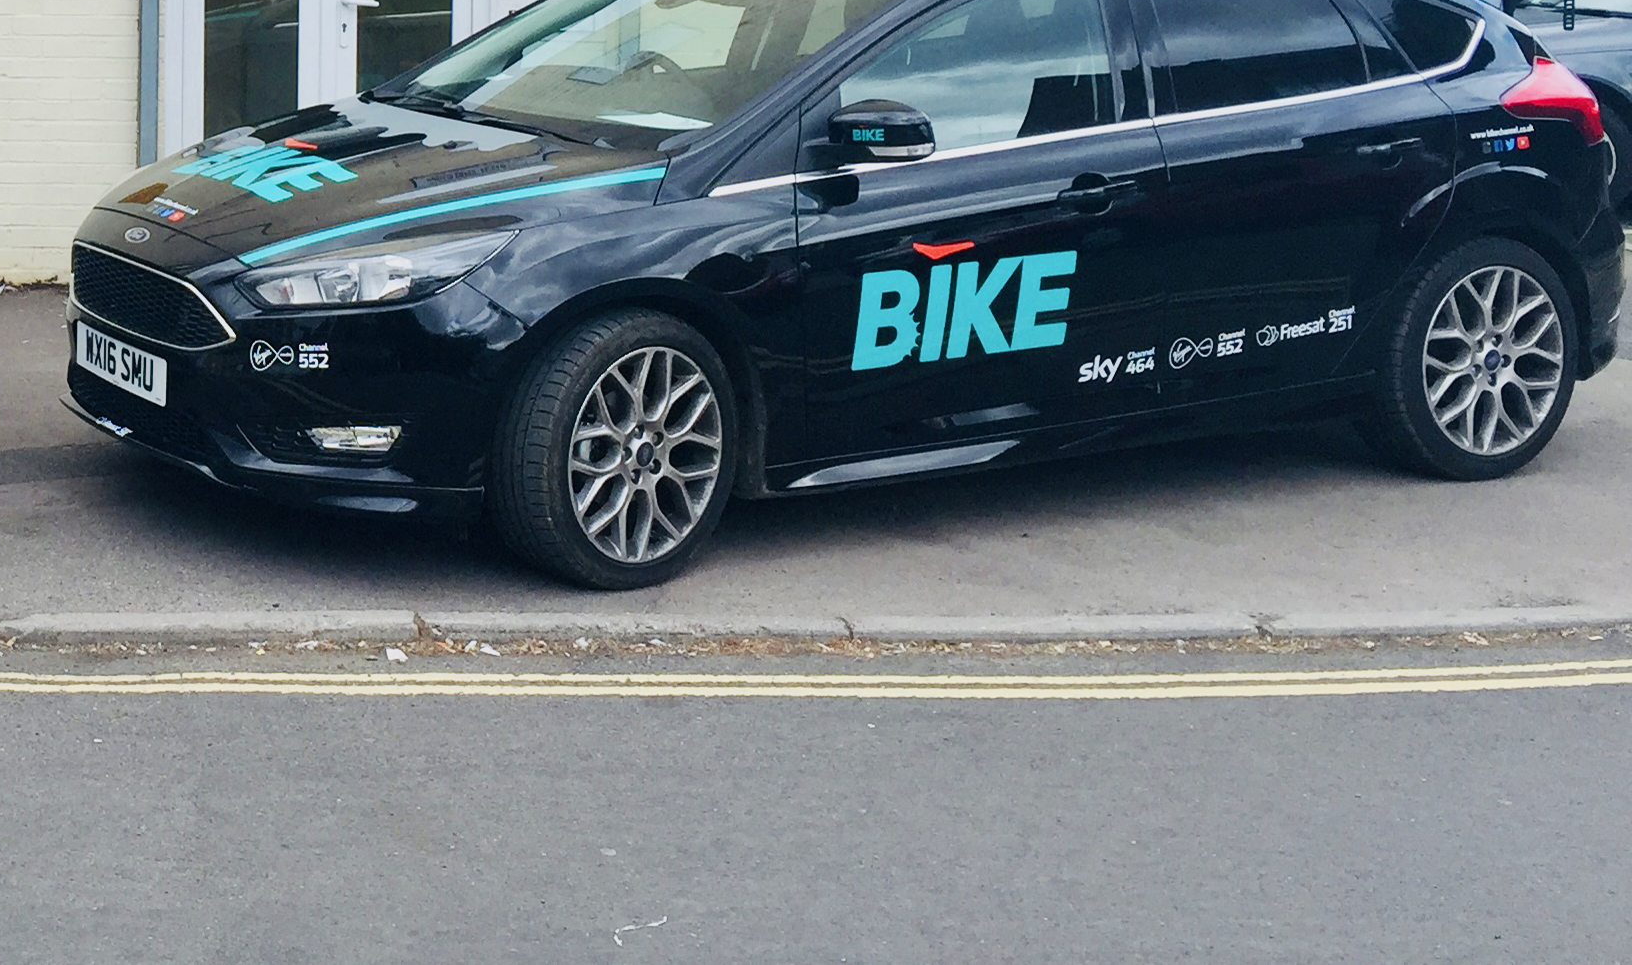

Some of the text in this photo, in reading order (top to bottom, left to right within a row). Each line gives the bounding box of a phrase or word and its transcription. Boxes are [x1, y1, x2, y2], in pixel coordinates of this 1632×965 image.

[852, 128, 885, 142] BIKE
[170, 145, 358, 203] BIKE
[851, 250, 1078, 371] BIKE
[1279, 317, 1325, 341] Freesat
[1328, 314, 1353, 334] 251
[298, 342, 329, 352] Channel
[1217, 338, 1243, 358] 552
[86, 329, 154, 393] WX16 SMU
[298, 353, 330, 369] 552
[1078, 354, 1123, 383] sky
[1125, 356, 1155, 375] 464
